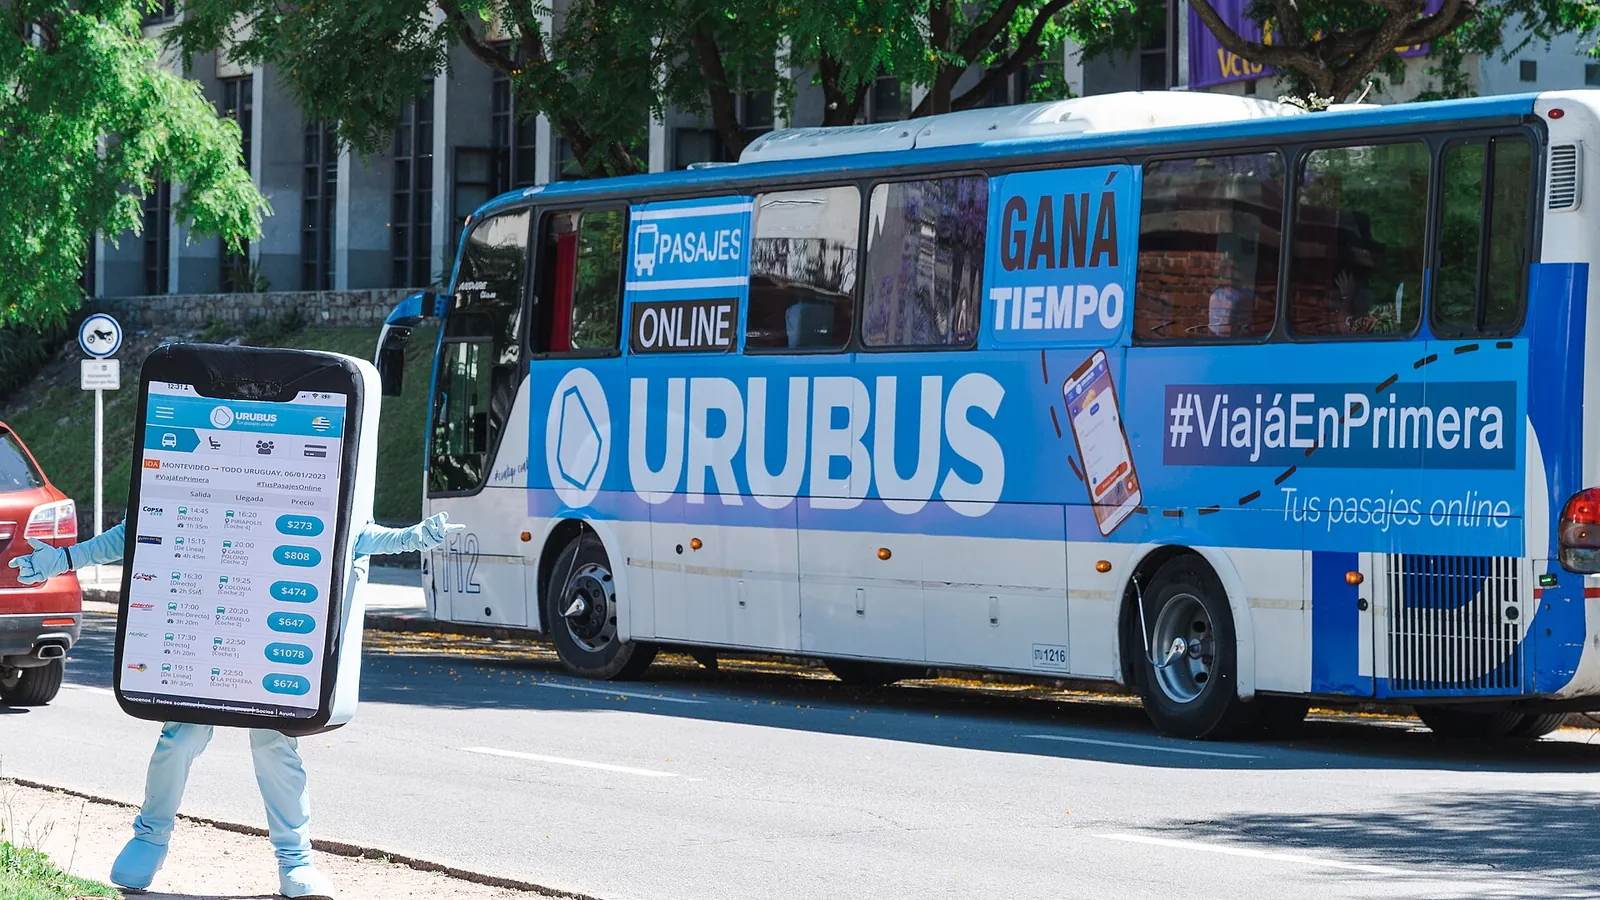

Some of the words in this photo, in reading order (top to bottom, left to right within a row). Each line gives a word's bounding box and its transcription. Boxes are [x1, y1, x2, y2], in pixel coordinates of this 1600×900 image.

[1001, 170, 1119, 272] GANÁ
[659, 228, 742, 264] PASAJES
[989, 282, 1124, 330] TIEMPO
[639, 305, 731, 348] ONLINE
[235, 412, 278, 422] URUBUS
[1170, 393, 1504, 462] #ViajáEnPrimera
[628, 373, 1005, 518] URUBUS
[162, 462, 210, 471] MONTEVIDEO
[244, 468, 283, 477] URUGUAY,
[284, 471, 326, 480] 06/01/2023
[256, 482, 322, 492] #TusPasajesOnline
[236, 494, 264, 503] Llegada
[1280, 488, 1320, 522] Tus
[1328, 492, 1421, 532] pasajes
[1430, 490, 1510, 528] online
[287, 520, 313, 530] $273
[284, 551, 310, 561] $808
[281, 586, 307, 597] $474
[180, 603, 200, 611] 17:00
[278, 618, 304, 628] $647
[177, 634, 196, 642] 17:30
[272, 648, 304, 659] $1078
[1044, 649, 1066, 662] 1216
[174, 664, 194, 672] 19:15
[274, 679, 300, 690] $674
